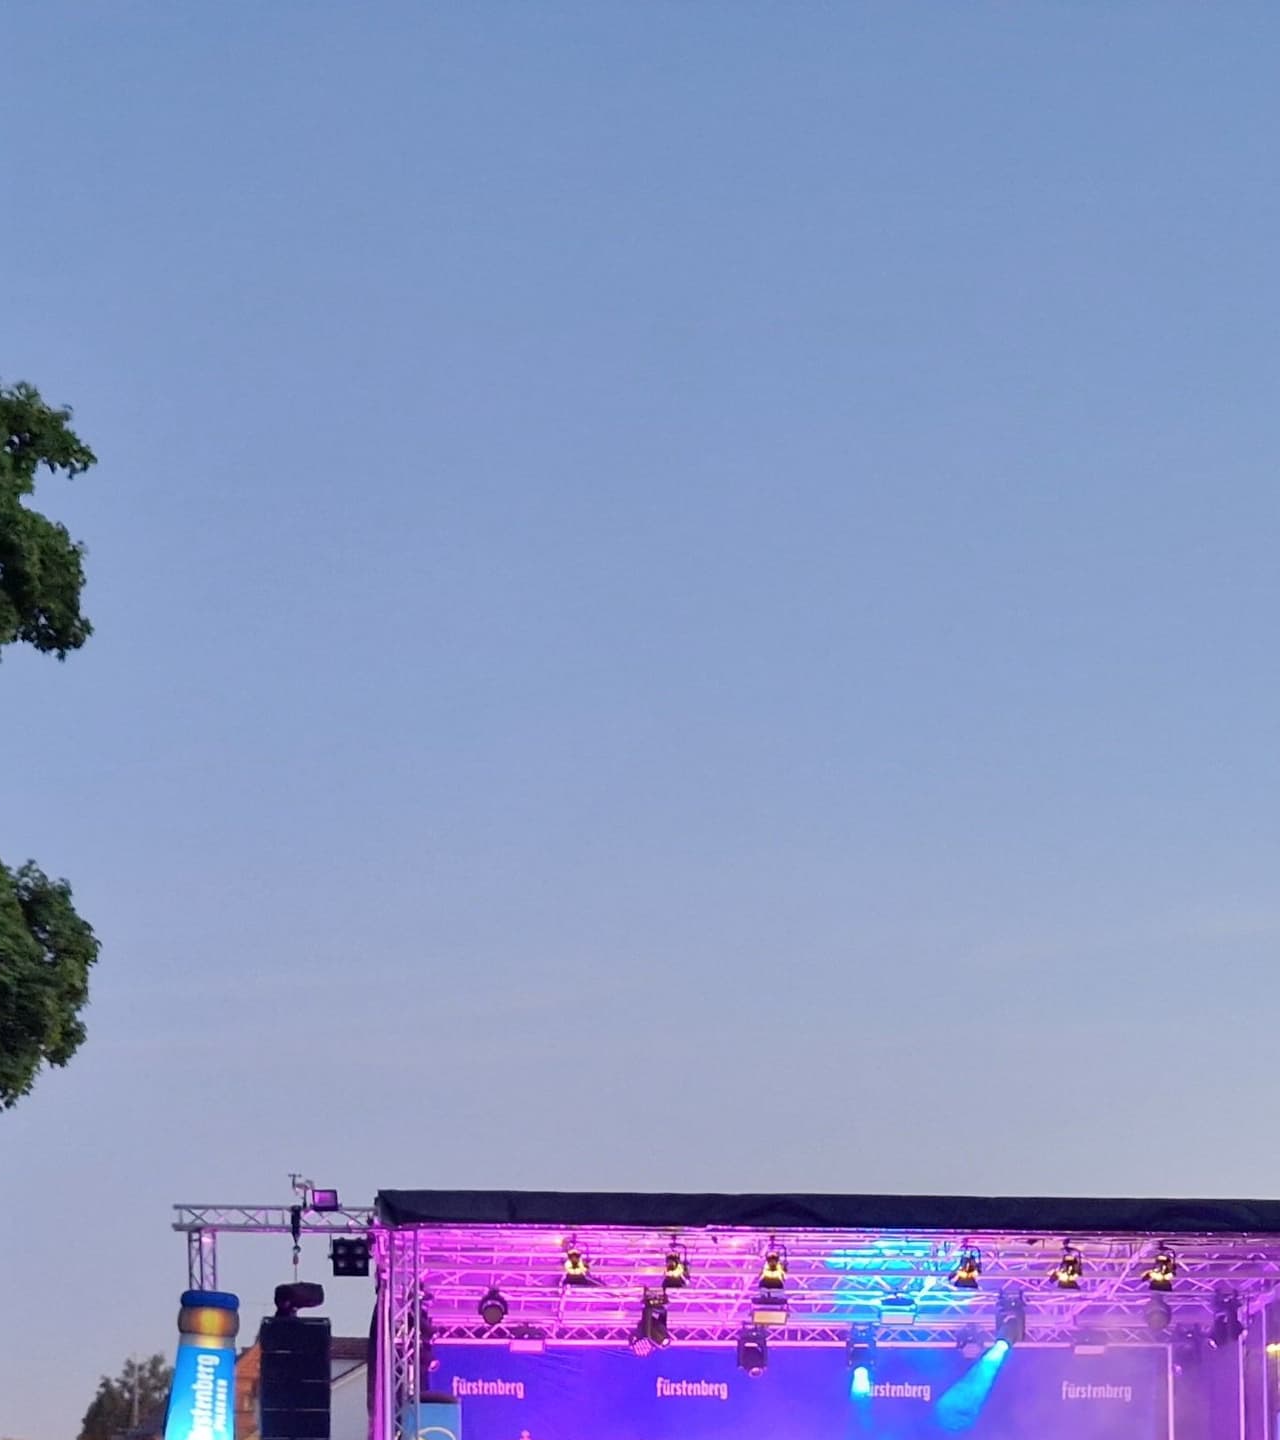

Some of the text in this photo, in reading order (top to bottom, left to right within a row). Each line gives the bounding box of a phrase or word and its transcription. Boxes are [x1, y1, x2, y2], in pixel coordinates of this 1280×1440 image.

[452, 1376, 524, 1399] fürstenberg
[656, 1377, 728, 1400] fürstenberg
[866, 1381, 931, 1400] ürstenberg
[1062, 1381, 1132, 1401] fürstenberg
